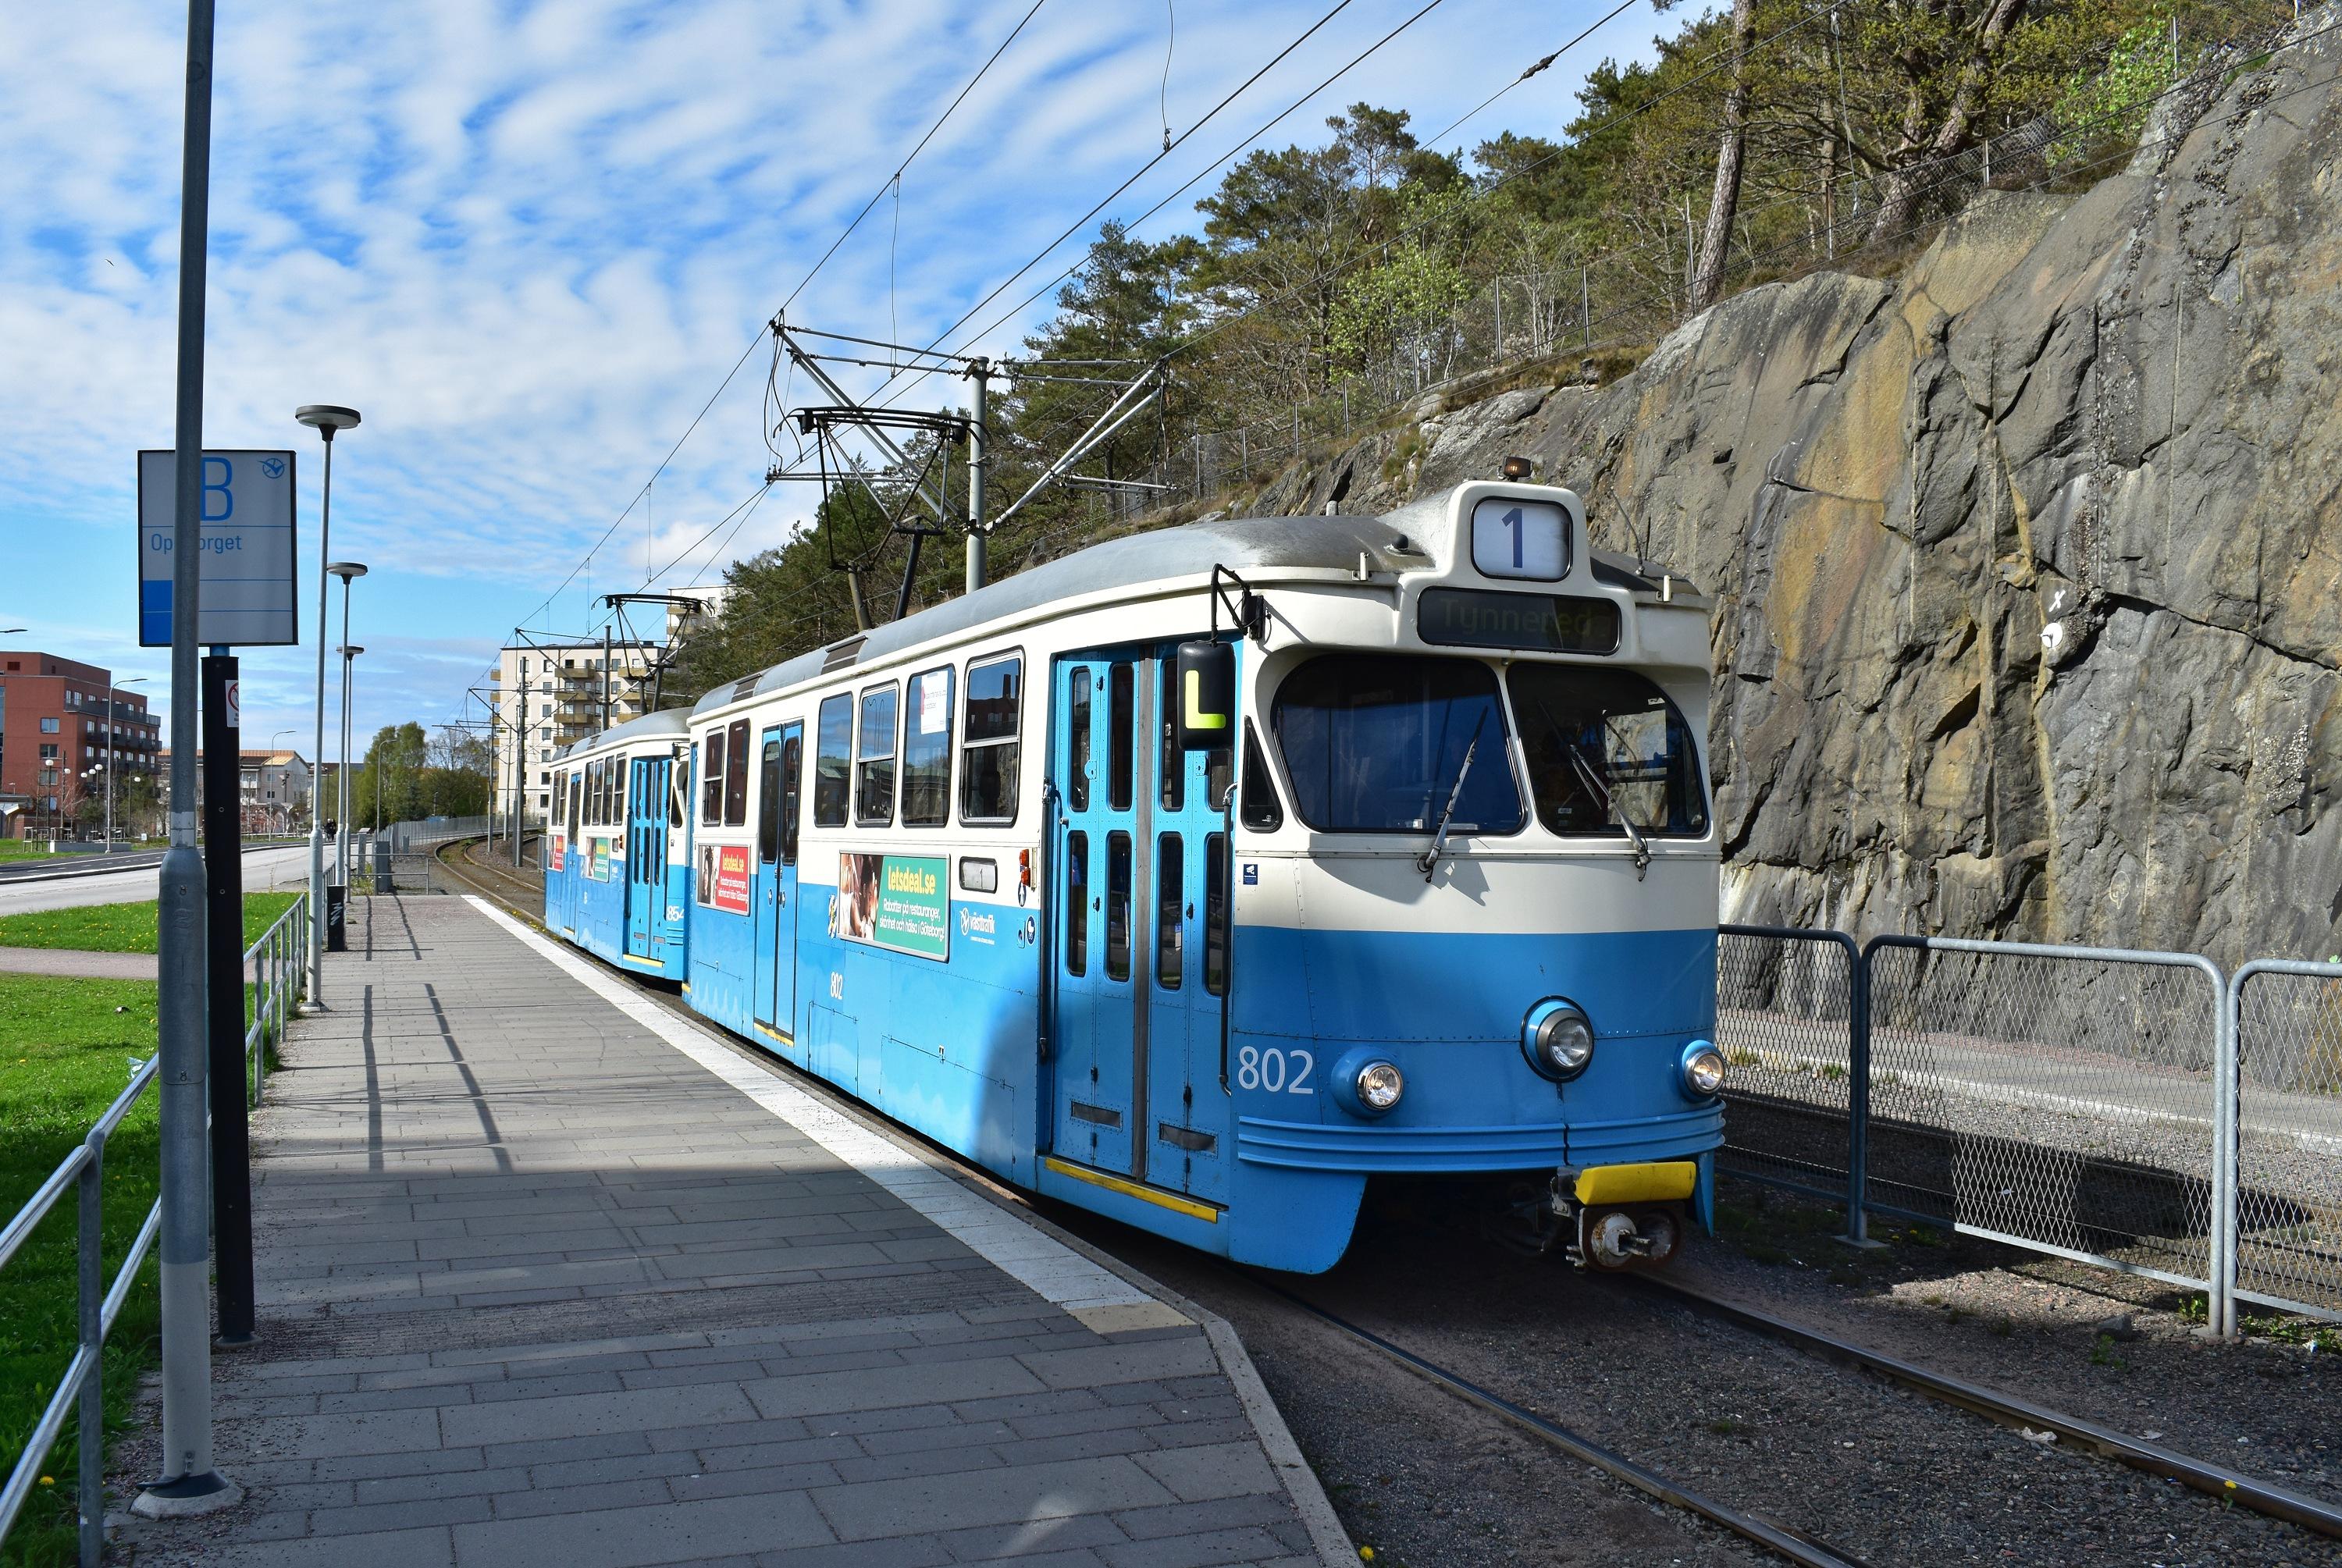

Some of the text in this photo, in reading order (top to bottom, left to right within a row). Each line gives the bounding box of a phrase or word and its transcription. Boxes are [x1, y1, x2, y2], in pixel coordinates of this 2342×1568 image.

[200, 457, 233, 521] B
[151, 533, 243, 554] Oporget
[1501, 507, 1523, 569] 1
[1440, 597, 1592, 637] Tynnered
[888, 866, 936, 895] letsdeal.se
[883, 898, 902, 913] Rabatter
[896, 918, 905, 932] och
[830, 971, 843, 1000] 802
[1238, 1045, 1314, 1094] 802
